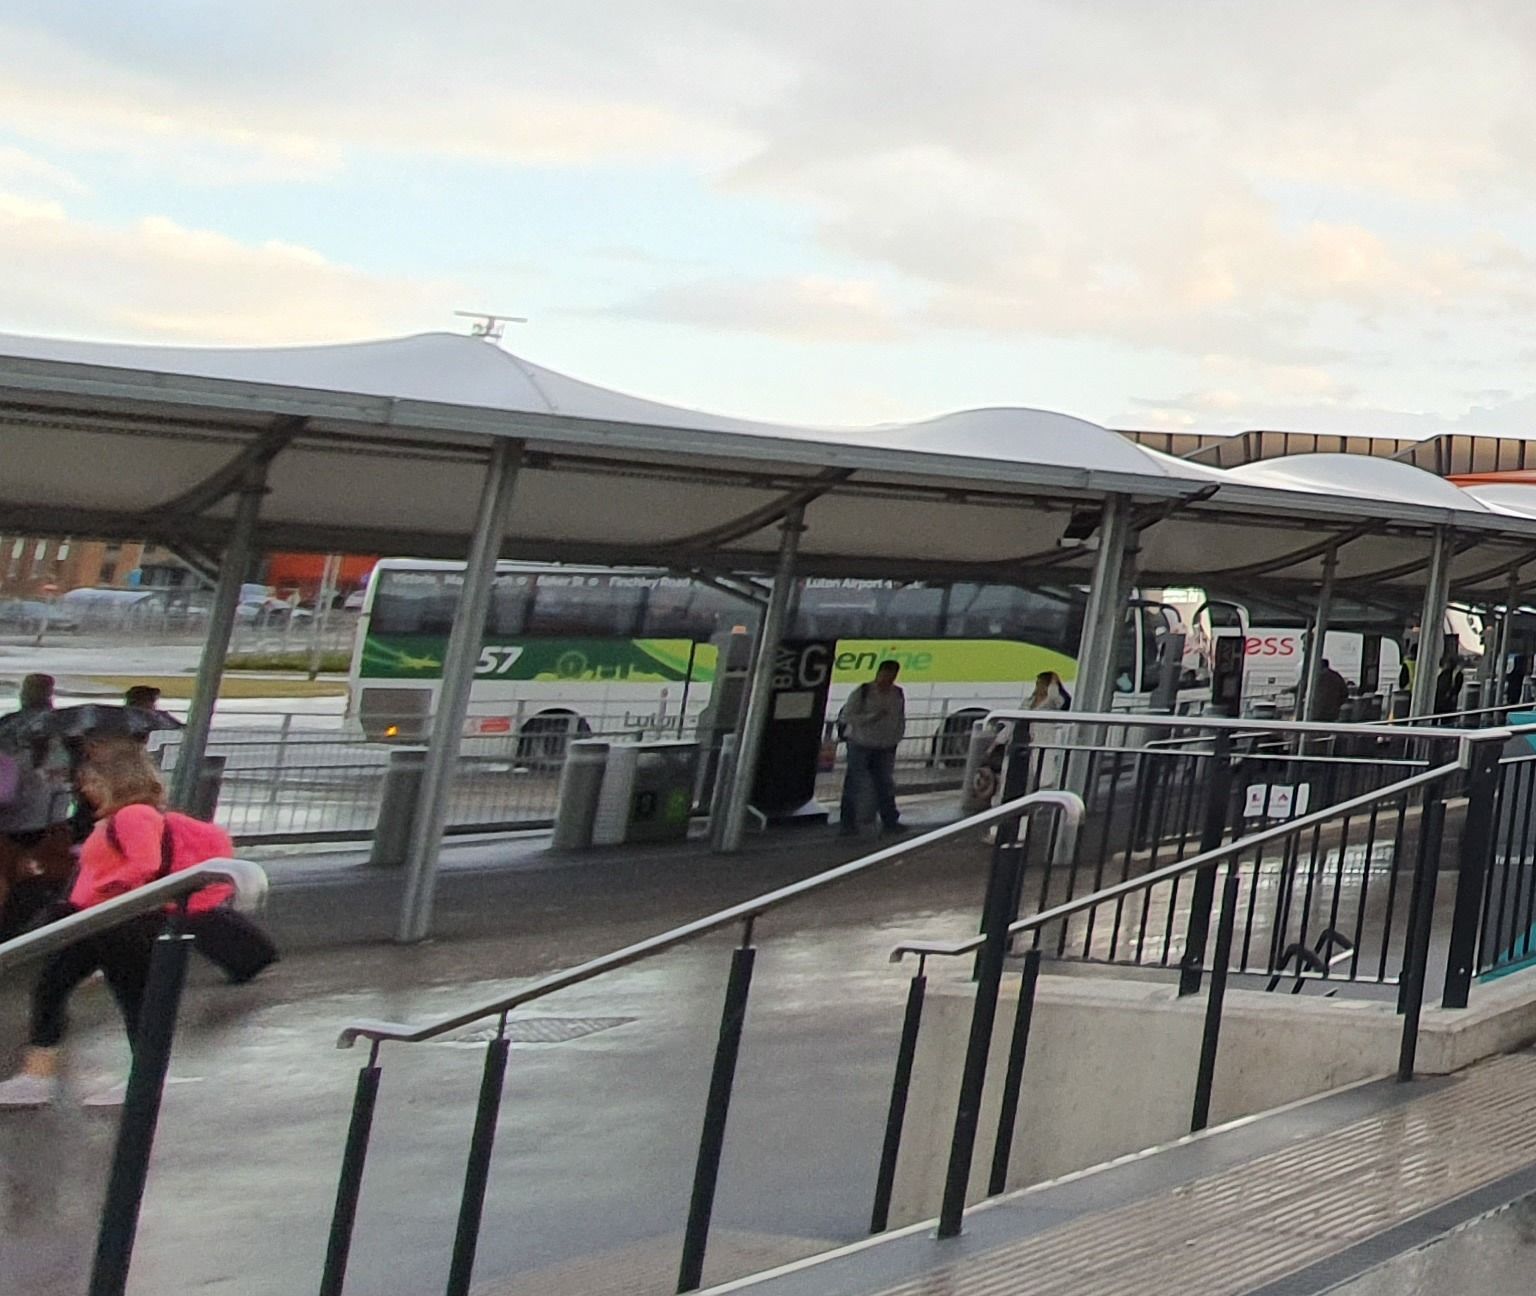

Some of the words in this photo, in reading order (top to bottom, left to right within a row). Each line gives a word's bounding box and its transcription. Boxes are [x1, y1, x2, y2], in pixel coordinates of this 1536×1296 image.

[806, 578, 841, 589] Luton
[842, 578, 884, 590] Airport
[799, 644, 828, 687] G
